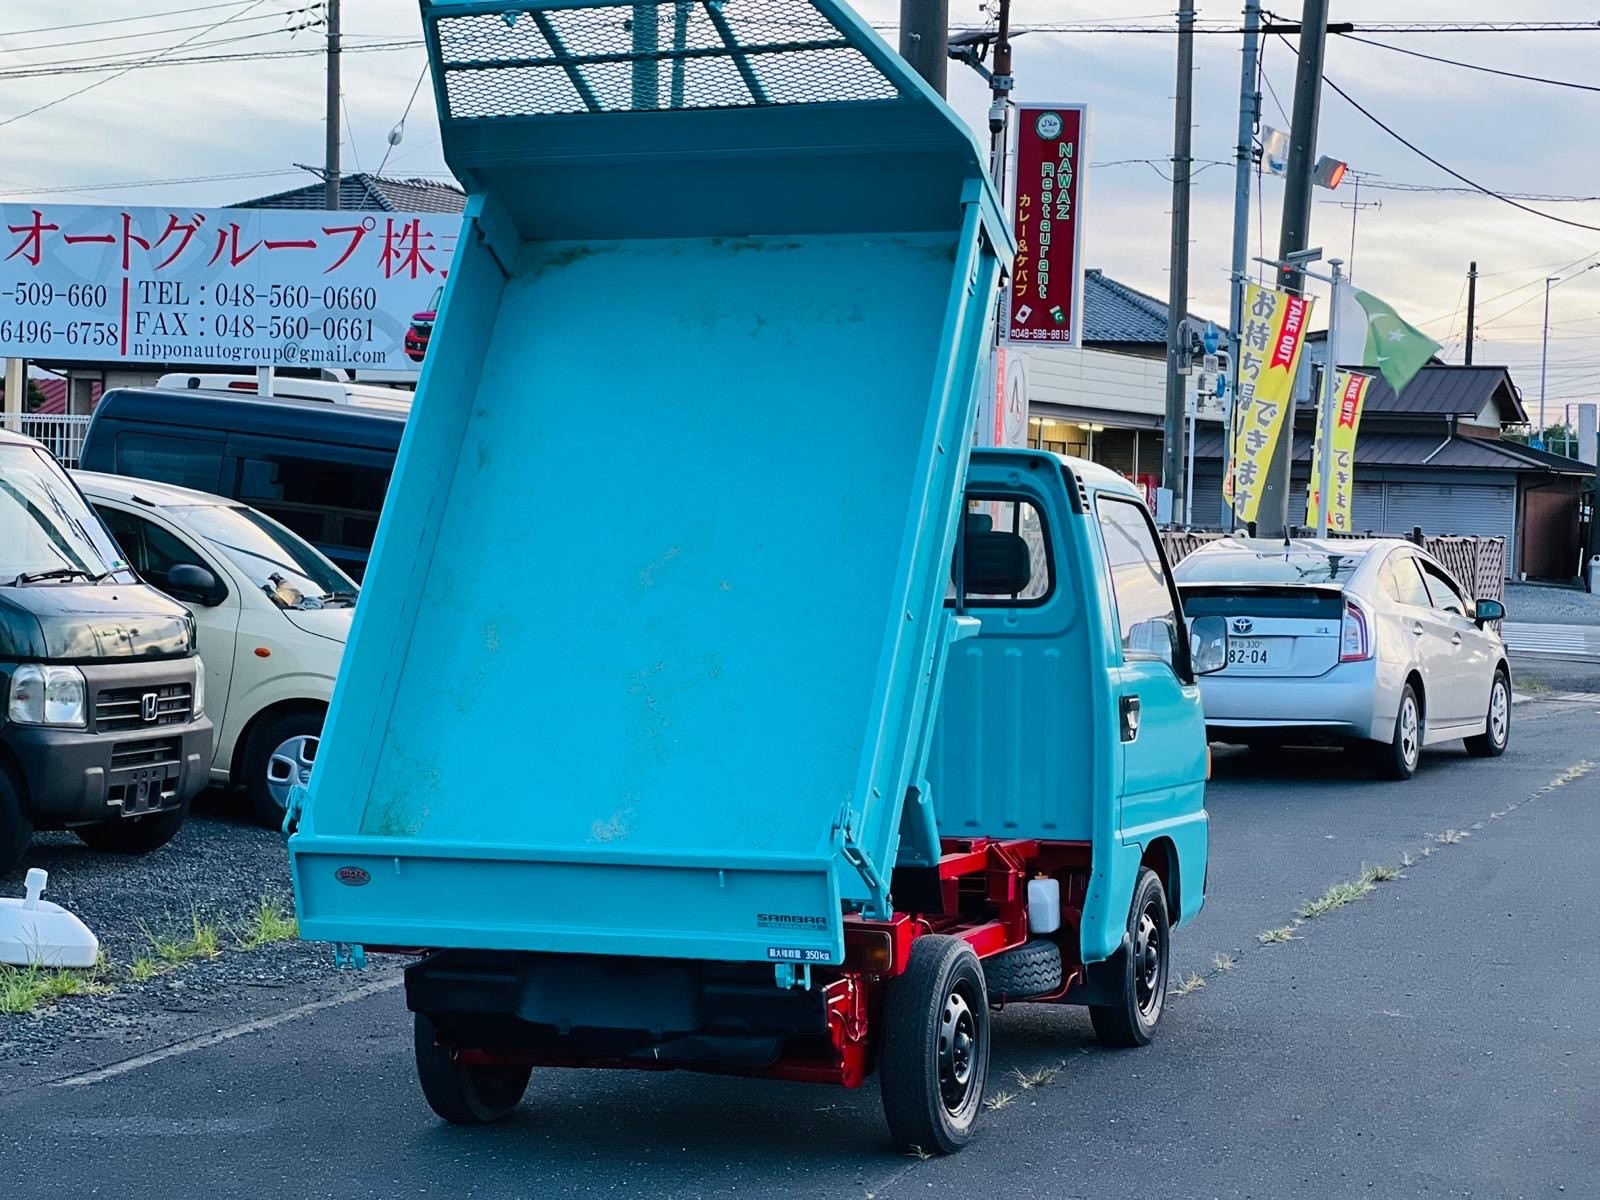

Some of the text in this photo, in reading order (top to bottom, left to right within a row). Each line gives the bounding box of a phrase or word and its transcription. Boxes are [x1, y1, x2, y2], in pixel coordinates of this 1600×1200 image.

[1056, 142, 1073, 220] NAWAZ
[1016, 194, 1031, 296] カレー&ケバブ
[1038, 162, 1055, 299] Restaurant
[215, 283, 376, 311] 048-560-0660
[215, 313, 374, 342] 048-560-0661
[1278, 299, 1303, 363] TAKE OUT
[134, 342, 386, 364] nipponautogroup@gmail.com
[1342, 376, 1363, 423] TAKE OUT
[1236, 399, 1277, 514] できます
[1333, 449, 1349, 529] できます
[1229, 649, 1267, 664] 82-04
[1246, 641, 1260, 649] 330
[757, 913, 827, 925] SAMBAR
[805, 950, 830, 961] 350kg
